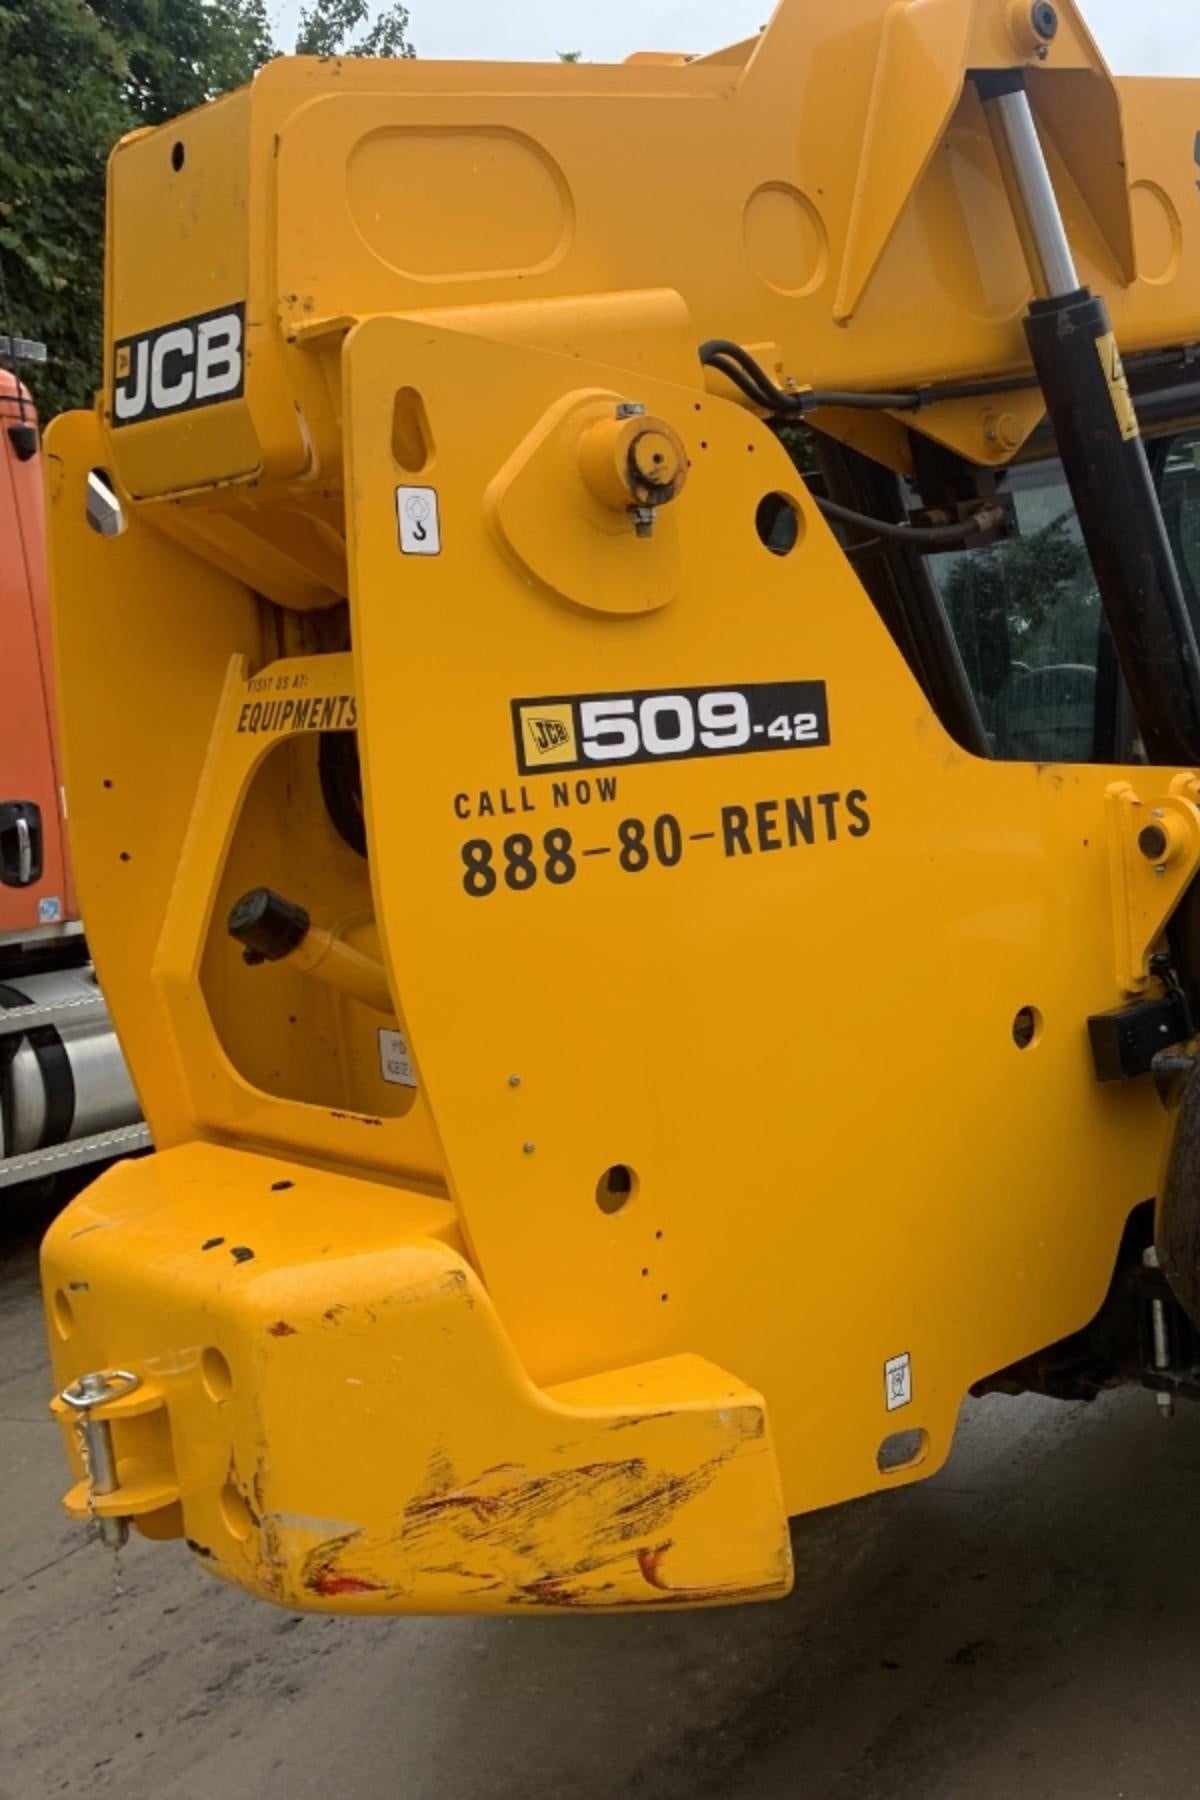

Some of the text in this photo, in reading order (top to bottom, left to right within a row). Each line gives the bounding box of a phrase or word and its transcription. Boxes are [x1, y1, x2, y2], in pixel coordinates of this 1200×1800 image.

[115, 312, 243, 420] JCB
[236, 695, 358, 735] EQUIPMENTS
[533, 718, 568, 750] JCB
[579, 691, 820, 761] 509-42
[453, 777, 619, 820] CALL NOW
[460, 789, 871, 898] 888-80-RENTS
